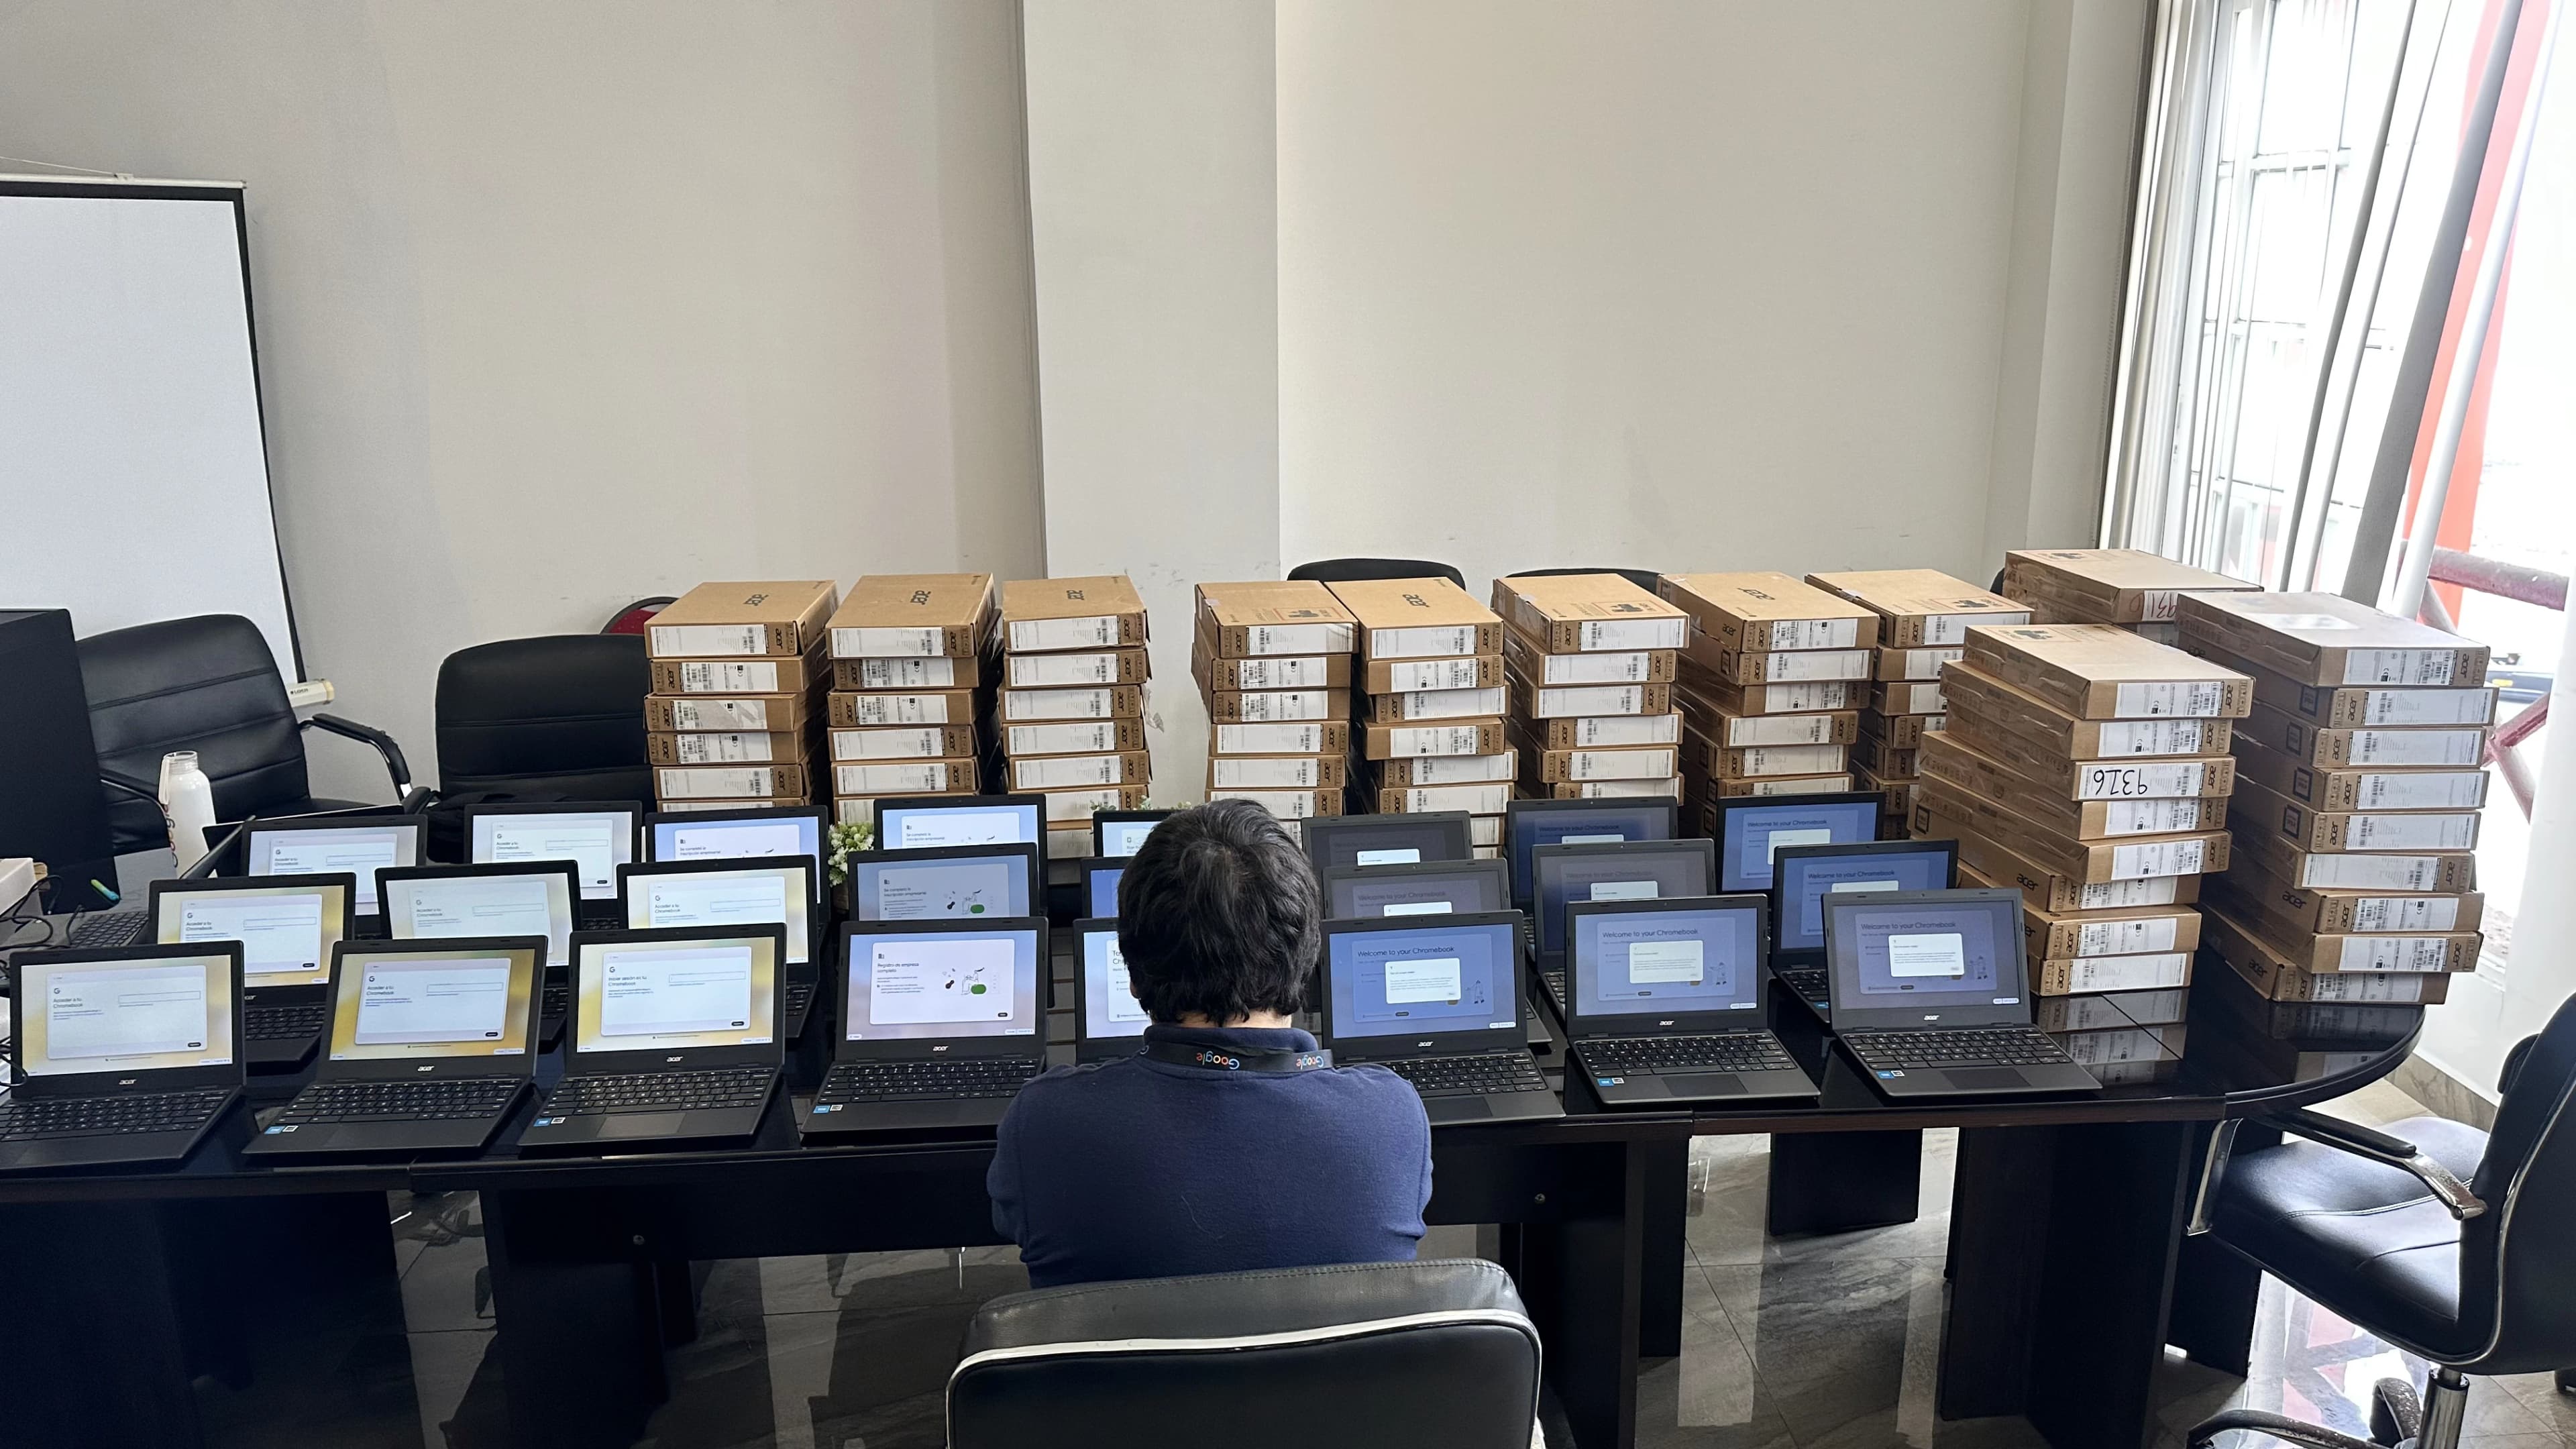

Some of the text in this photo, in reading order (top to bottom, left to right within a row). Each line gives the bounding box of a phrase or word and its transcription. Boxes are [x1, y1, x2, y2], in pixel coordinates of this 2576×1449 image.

[1402, 594, 1430, 608] acer
[775, 629, 783, 649] acer
[2460, 653, 2469, 678] acer
[2224, 686, 2233, 709] acer
[2348, 696, 2357, 721] acer
[2206, 723, 2214, 748] acer
[2332, 736, 2341, 761] acer
[2093, 768, 2148, 796] 9316
[2208, 765, 2216, 790] acer
[2344, 778, 2353, 804] acer
[2329, 821, 2339, 846] acer
[2016, 873, 2038, 892] acer
[2445, 861, 2455, 885] acer
[2282, 890, 2308, 911] acer
[2341, 905, 2349, 928] acer
[1358, 949, 1387, 957] Welcome
[1397, 949, 1411, 957] your
[1412, 946, 1454, 955] Chromebook
[2065, 929, 2075, 953] acer
[2453, 942, 2461, 966] acer
[2056, 965, 2065, 989] acer
[2249, 958, 2268, 978] acer
[2298, 975, 2307, 999] acer
[1195, 1051, 1240, 1070] Google
[1295, 1055, 1324, 1070] Google
